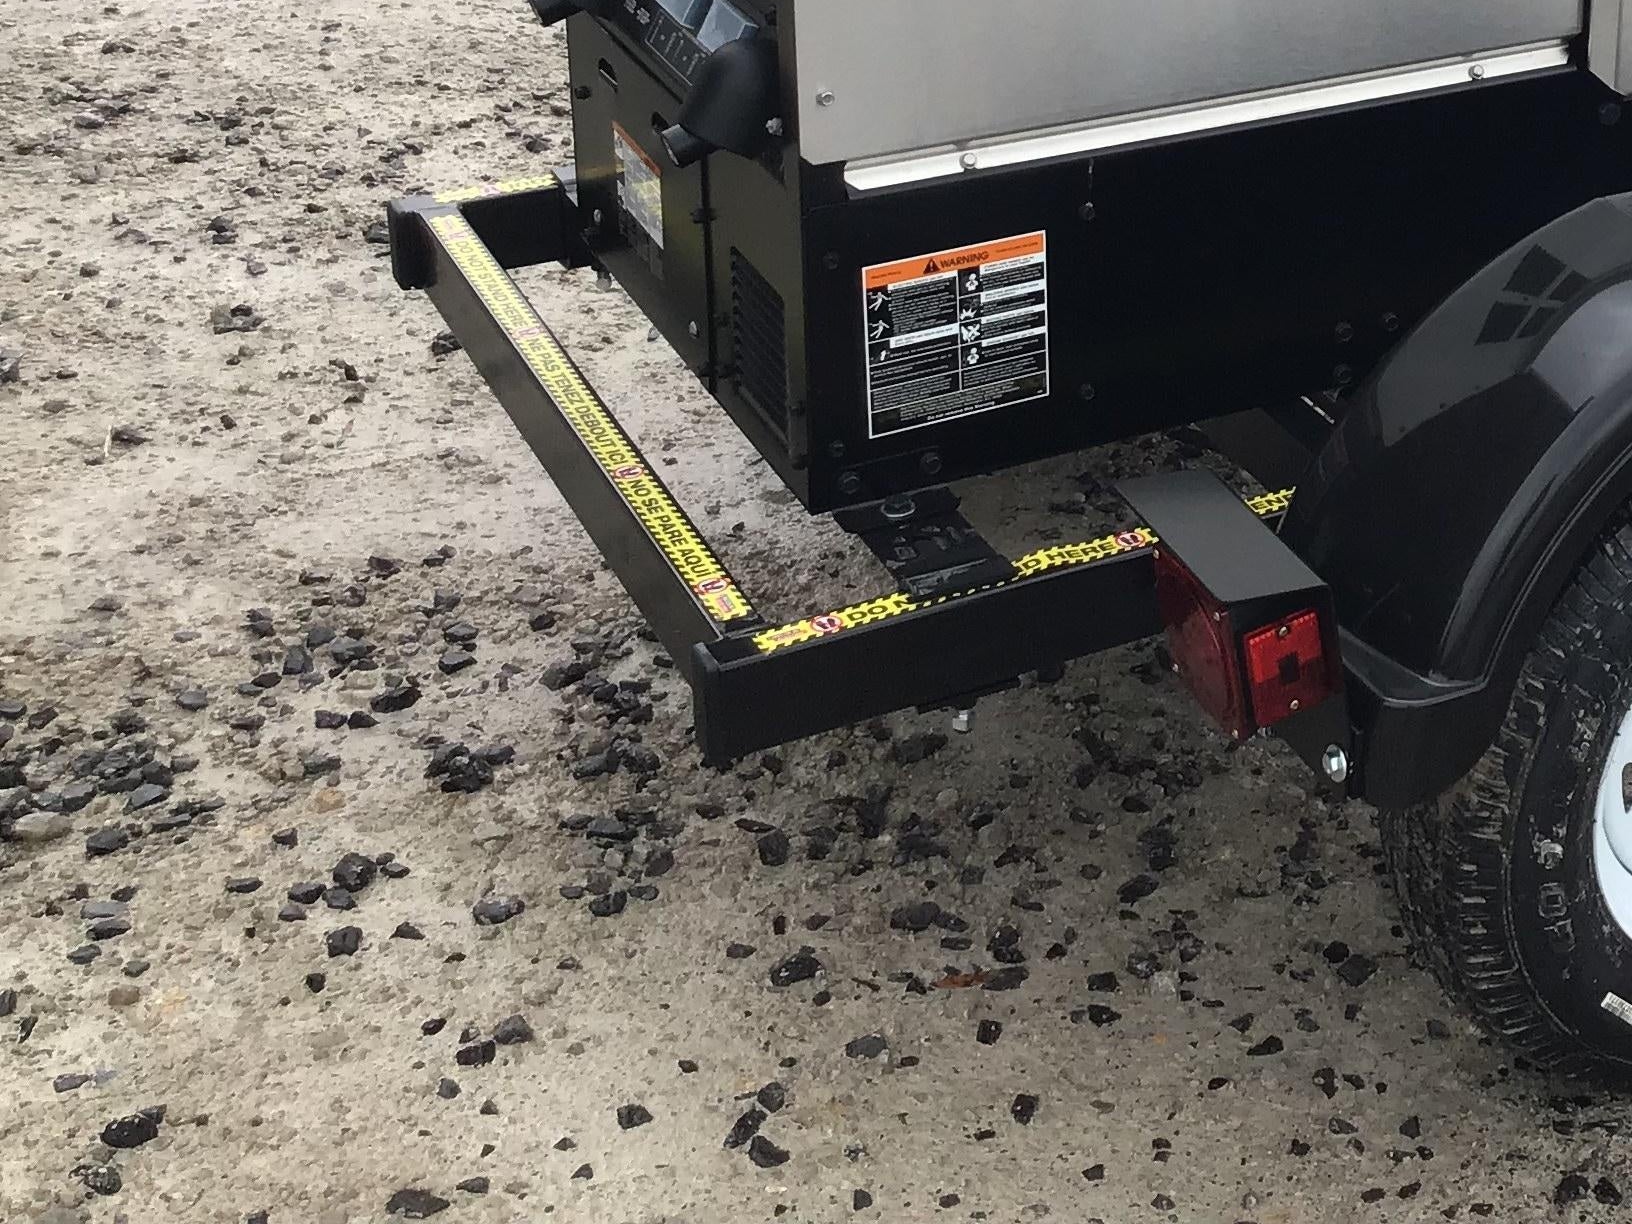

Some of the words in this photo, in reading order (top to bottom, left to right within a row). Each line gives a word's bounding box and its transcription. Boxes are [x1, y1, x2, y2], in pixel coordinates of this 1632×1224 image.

[455, 241, 474, 254] DO
[467, 254, 488, 272] NOT
[478, 273, 509, 302] STAND
[502, 301, 529, 327] HERE
[939, 250, 990, 269] WARNING
[527, 337, 545, 353] NE
[538, 352, 561, 373] PAS
[551, 372, 586, 405] TENEZ
[574, 405, 618, 451] DEBOUT
[605, 449, 629, 466] ICI
[626, 478, 653, 498] NO
[640, 497, 665, 515] SE
[653, 515, 690, 547] PARE
[676, 547, 713, 578] AQUI
[1048, 541, 1114, 562] HERE
[847, 605, 888, 622] DO
